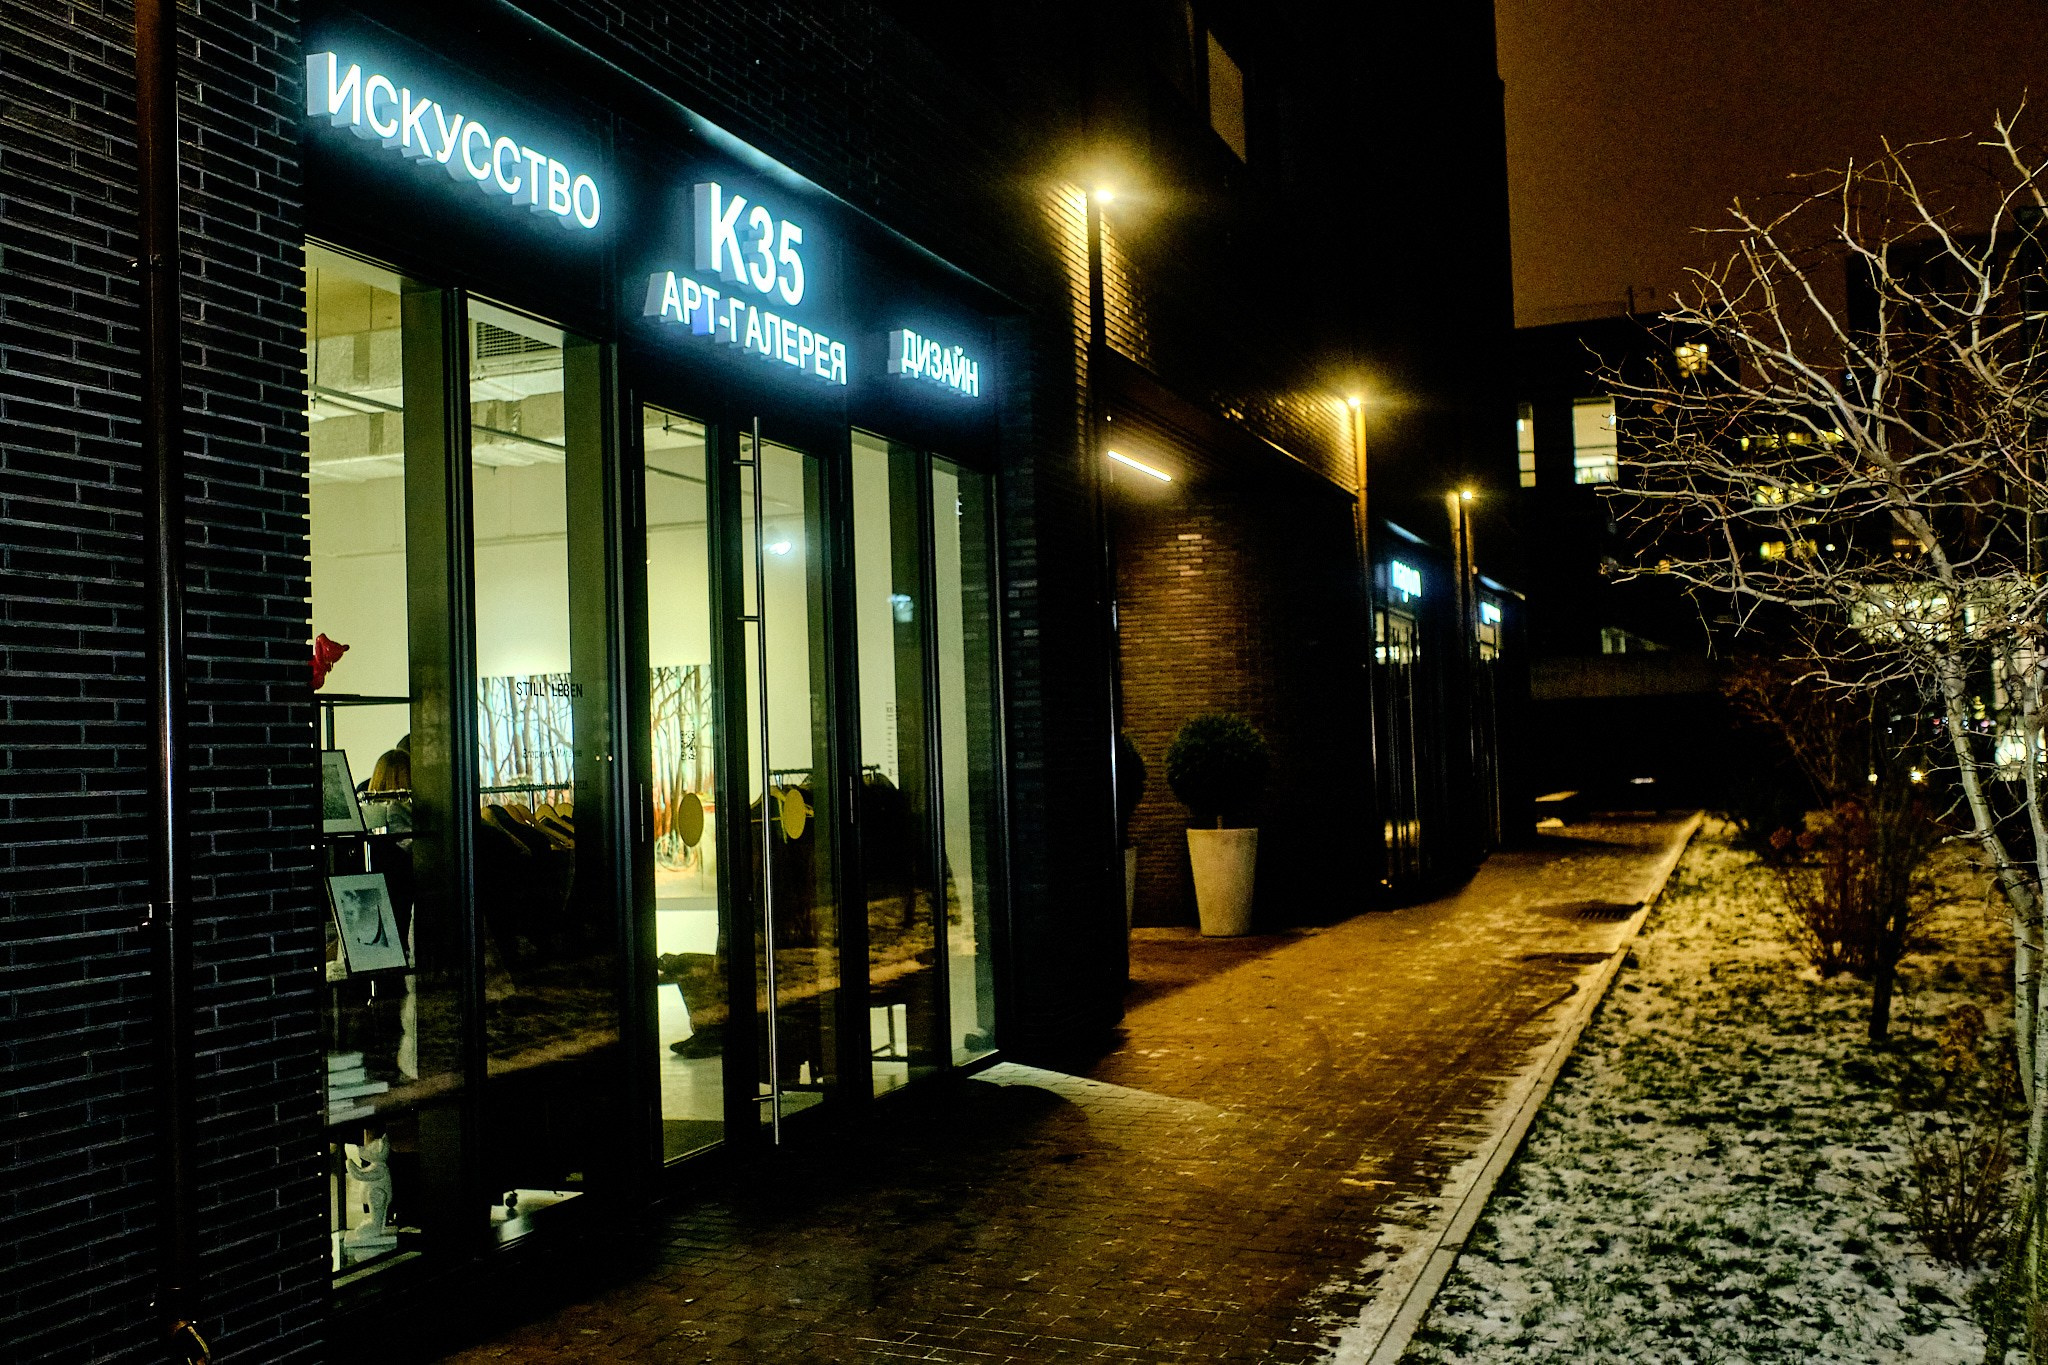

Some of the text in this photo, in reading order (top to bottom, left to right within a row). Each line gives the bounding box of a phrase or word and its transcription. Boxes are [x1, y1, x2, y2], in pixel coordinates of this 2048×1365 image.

[325, 52, 601, 230] ИСКУССТВО
[659, 271, 847, 386] АРТ-ГАЛЕРЕЯ
[899, 328, 979, 398] ДИЗАЙН
[516, 682, 584, 698] STILL LEBEN
